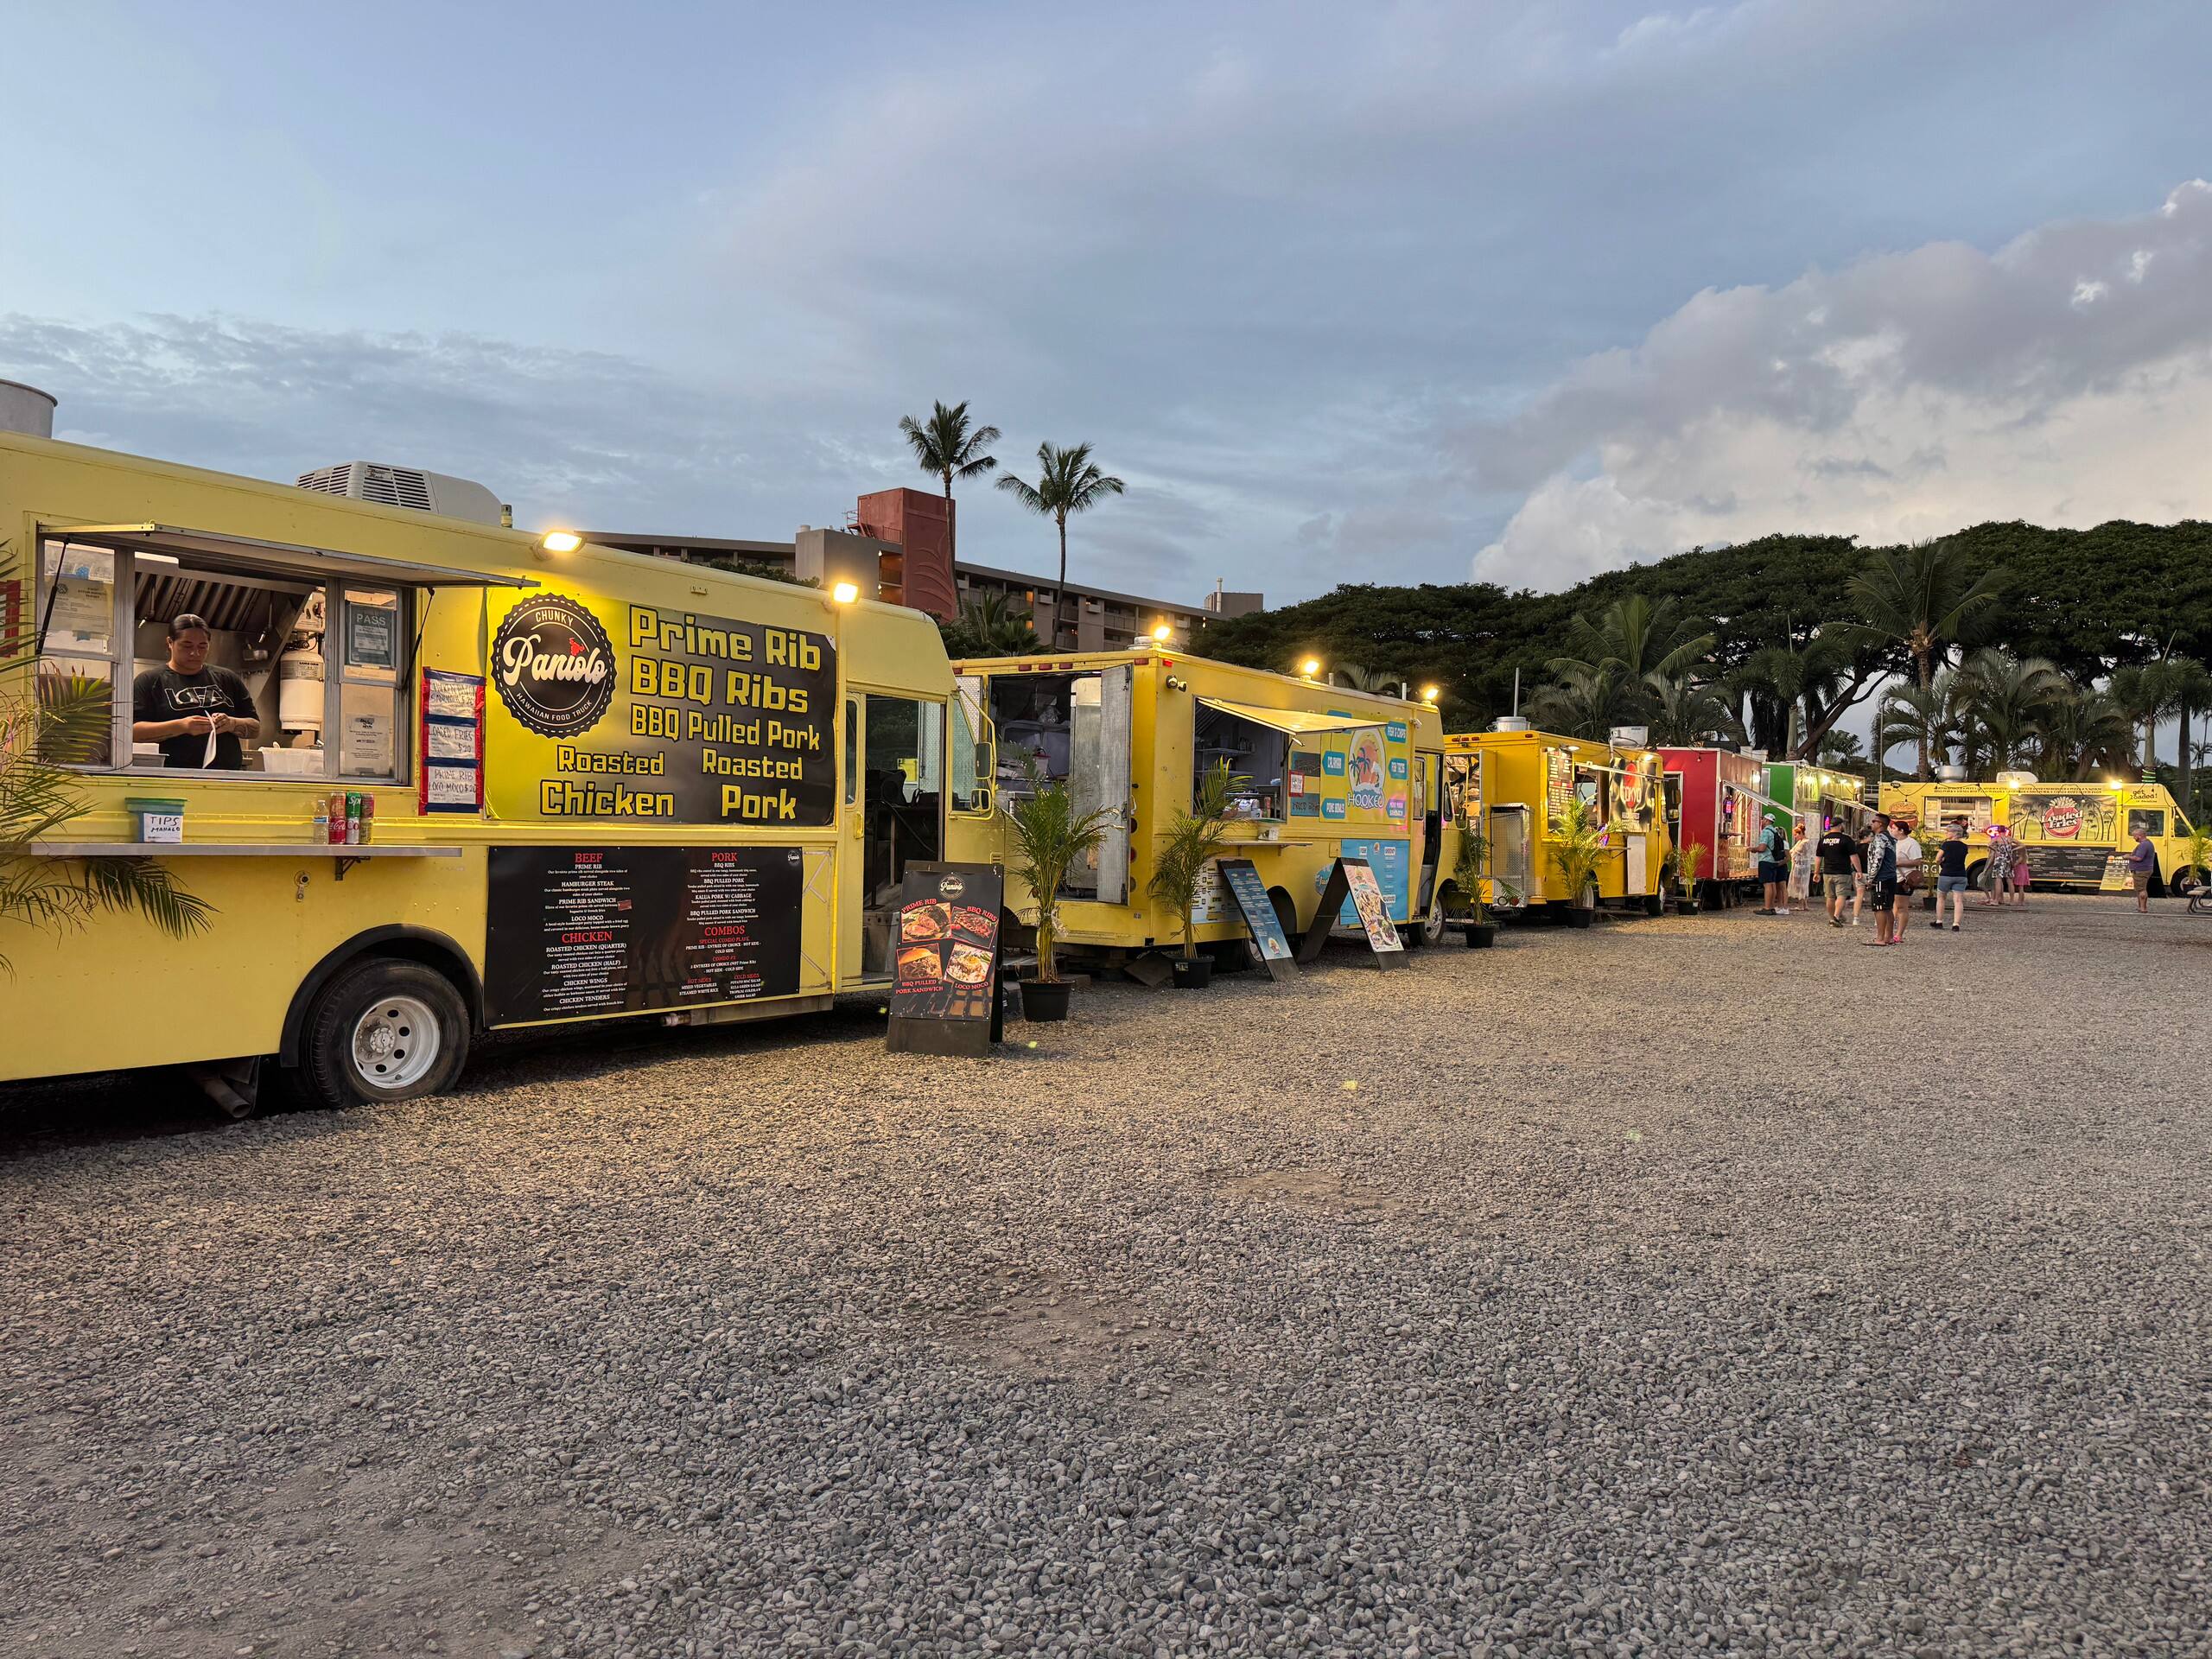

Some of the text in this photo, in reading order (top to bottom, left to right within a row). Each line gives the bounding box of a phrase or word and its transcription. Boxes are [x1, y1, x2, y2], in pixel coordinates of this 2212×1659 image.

[356, 613, 386, 626] PASS
[536, 609, 574, 626] CHUNKY
[629, 604, 822, 671] Prime Rib
[503, 634, 607, 686] Paniolo
[630, 654, 809, 714] BBQ Ribs
[517, 693, 550, 720] HAWAIIAN
[572, 700, 593, 717] TRUCK
[631, 703, 820, 751] BBQ Pulled Pork
[454, 728, 472, 741] FRIES
[458, 743, 472, 753] $20
[557, 745, 664, 776] Roasted
[702, 747, 803, 780] Roasted
[435, 769, 474, 781] PRIME RIB
[540, 779, 674, 817] Chicken
[721, 783, 798, 820] Pork
[150, 817, 180, 827] TIPS
[2041, 810, 2083, 823] Loaded
[2049, 819, 2078, 829] Fries
[575, 853, 603, 863] BEEF
[712, 853, 737, 861] PORK
[901, 899, 924, 913] PRIME
[967, 906, 997, 922] BBQ RIBS
[562, 931, 613, 943] CHICKEN
[704, 925, 745, 937] COMBOS
